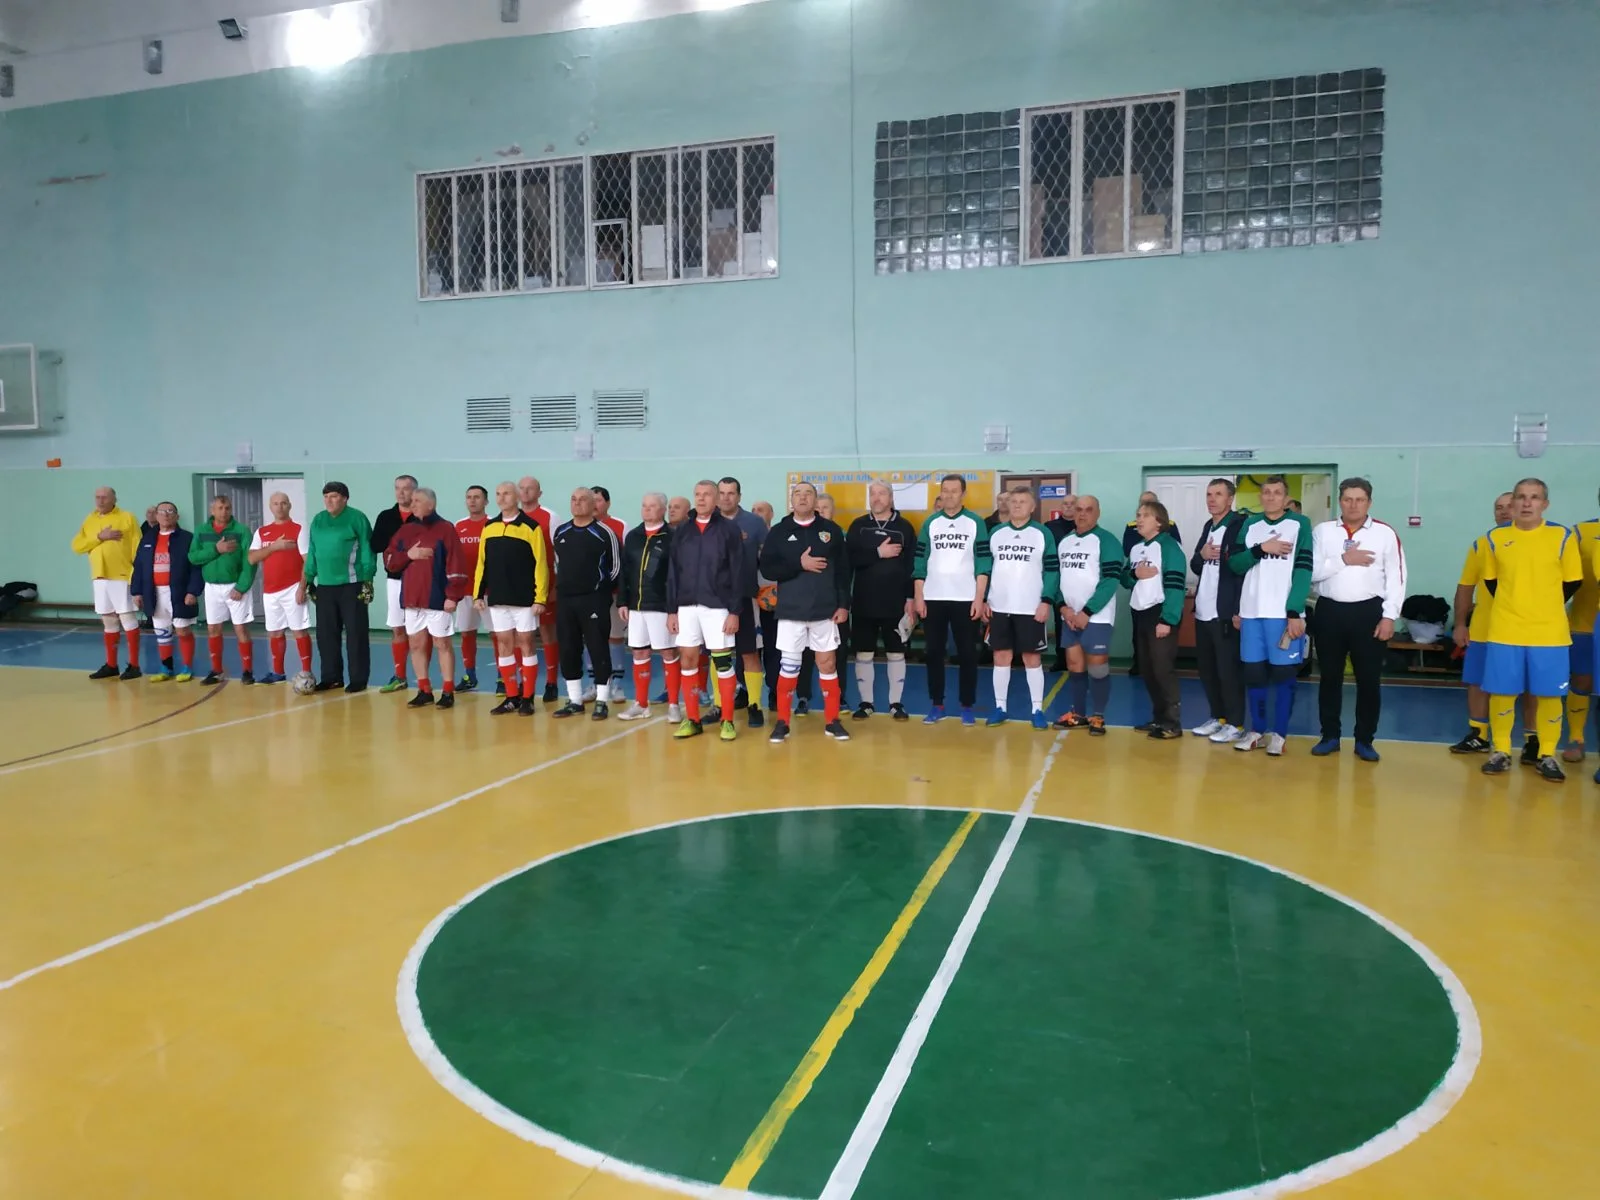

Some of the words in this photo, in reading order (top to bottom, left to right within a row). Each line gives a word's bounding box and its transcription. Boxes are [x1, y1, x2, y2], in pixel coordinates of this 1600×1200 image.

[933, 533, 970, 542] SPORT
[935, 542, 966, 550] DUWE
[997, 545, 1035, 553] SPORT
[999, 554, 1031, 562] DUWE
[1060, 552, 1090, 560] SPORT
